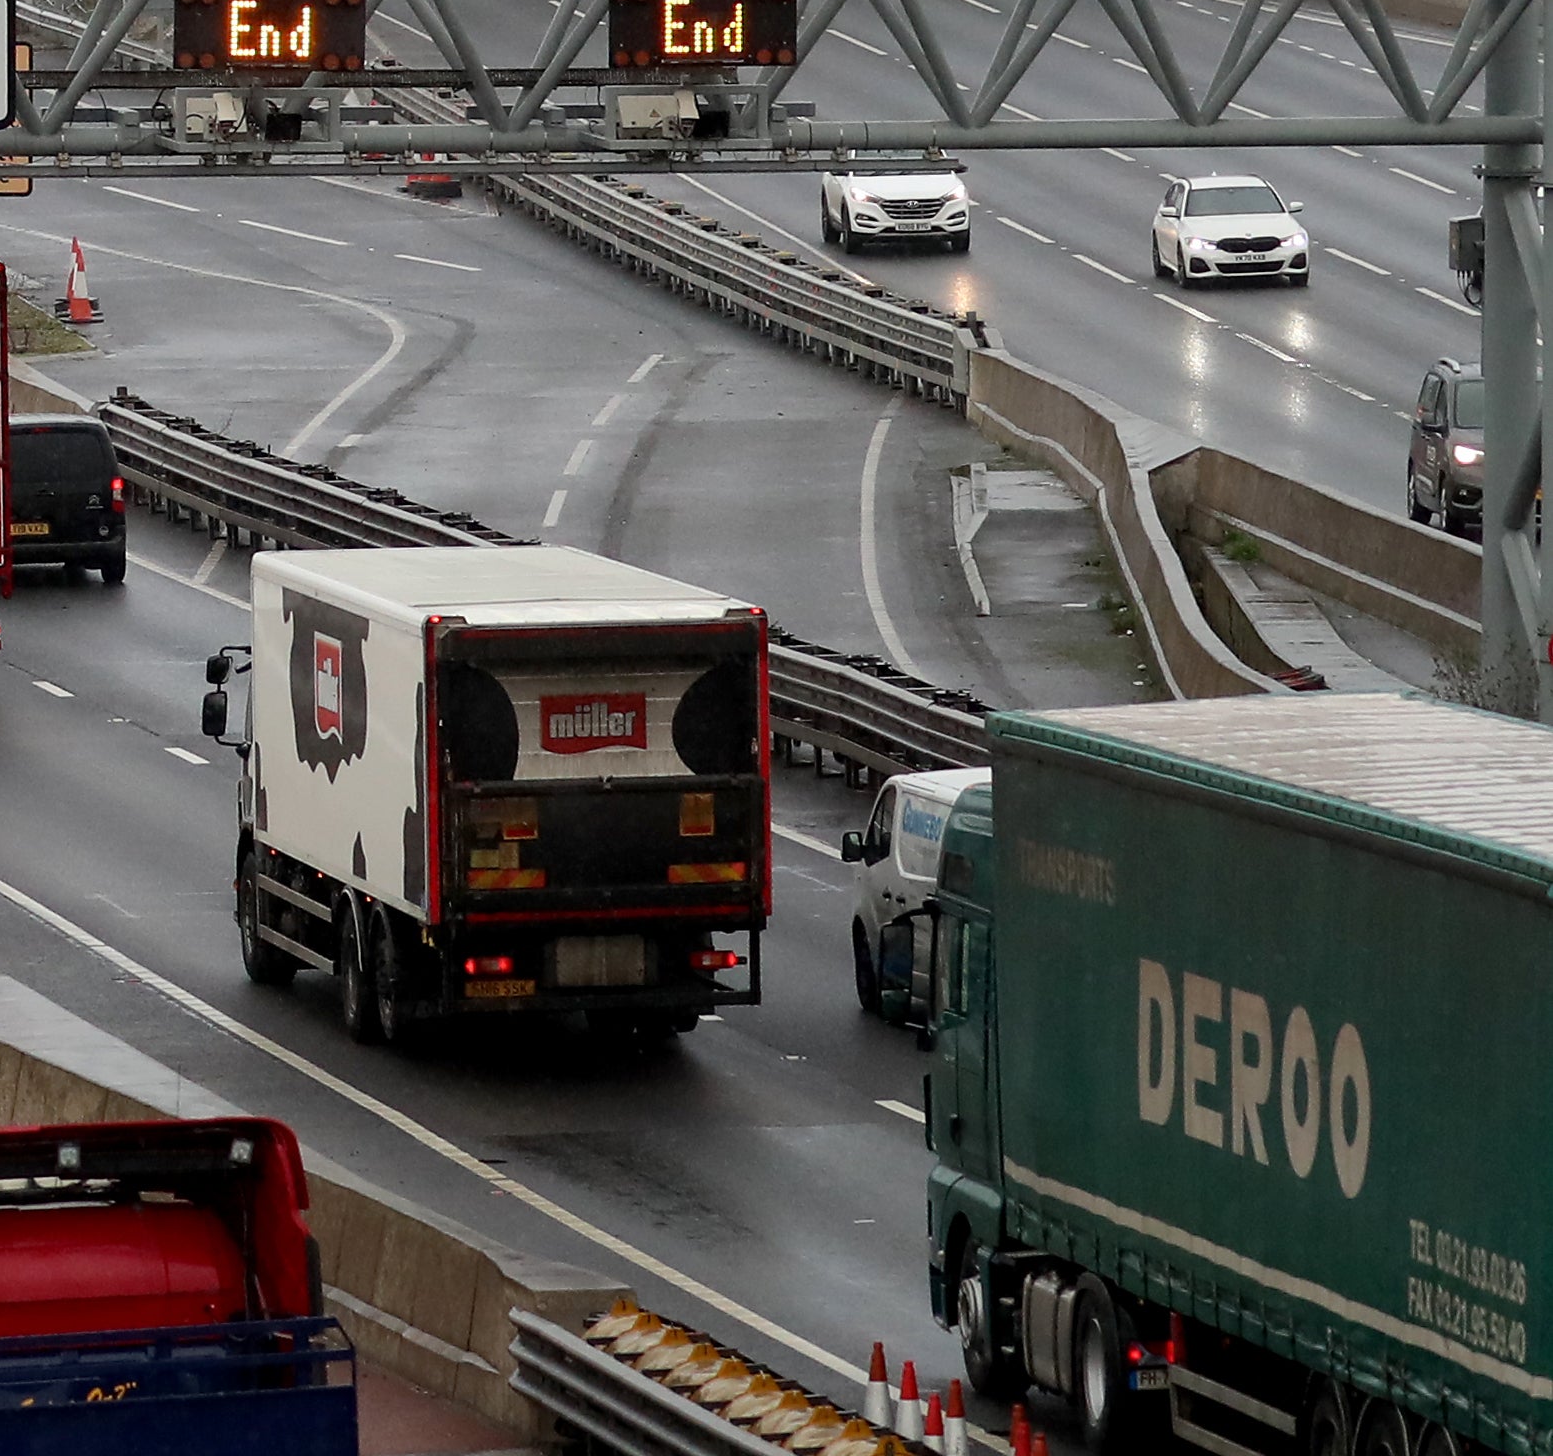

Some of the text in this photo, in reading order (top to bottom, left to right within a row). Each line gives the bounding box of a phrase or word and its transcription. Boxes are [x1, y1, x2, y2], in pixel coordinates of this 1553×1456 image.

[231, 0, 310, 57] End
[549, 703, 636, 739] müller
[1139, 958, 1371, 1199] DEROO
